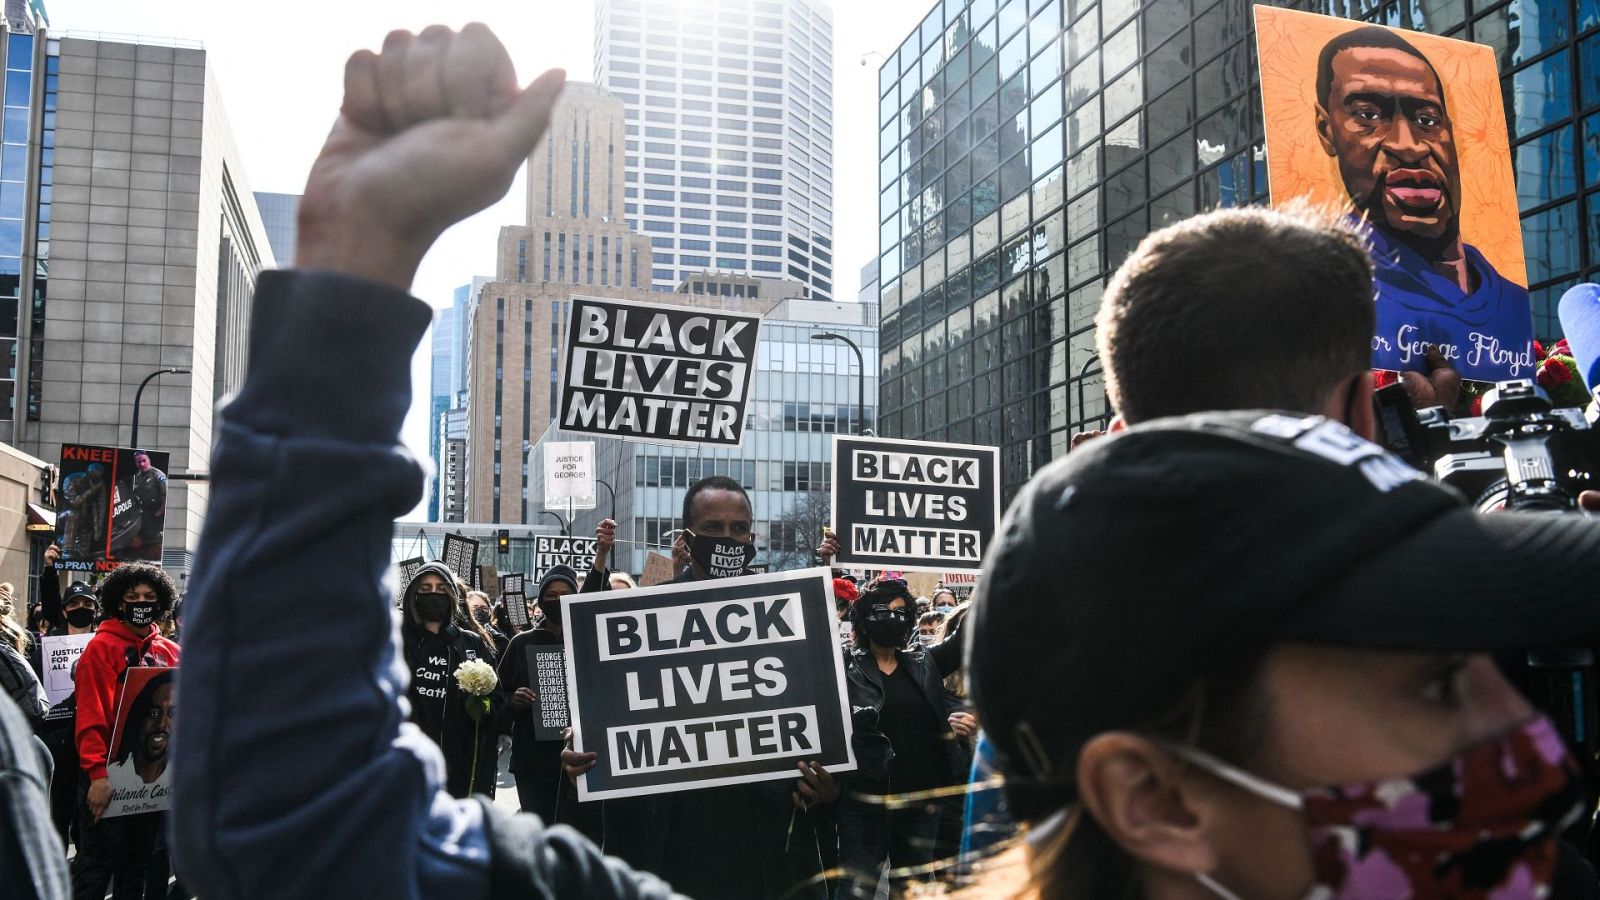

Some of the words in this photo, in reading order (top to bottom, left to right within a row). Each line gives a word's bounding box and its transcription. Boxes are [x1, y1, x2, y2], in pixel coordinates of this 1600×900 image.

[579, 305, 750, 359] BLACK
[1371, 336, 1391, 351] or
[1398, 324, 1460, 364] Geoge
[1467, 332, 1533, 377] Floyd
[582, 350, 734, 399] LIVES
[565, 391, 738, 440] MATTER
[856, 452, 975, 486] BLACK
[865, 489, 968, 522] LIVES
[538, 538, 597, 555] BLACK
[854, 527, 978, 558] MATTER
[714, 544, 745, 555] BLACK
[65, 561, 94, 570] PRAY
[541, 554, 593, 569] LIVES
[715, 555, 744, 567] LIVES
[944, 572, 976, 584] JUSTICE
[606, 598, 794, 656] BLACK
[51, 647, 85, 656] JUSTICE
[536, 653, 562, 661] GEORGE
[51, 656, 69, 664] FOR
[428, 656, 448, 666] We
[537, 661, 563, 669] GEORGE
[52, 663, 68, 671] ALL
[538, 669, 564, 677] GEORGE
[539, 677, 565, 685] GEORGE
[625, 656, 787, 712] LIVES
[540, 685, 566, 693] GEORGE
[540, 693, 566, 702] GEORGE
[541, 702, 567, 710] GEORGE
[542, 711, 568, 719] GEORGE
[615, 712, 813, 771] MATTER
